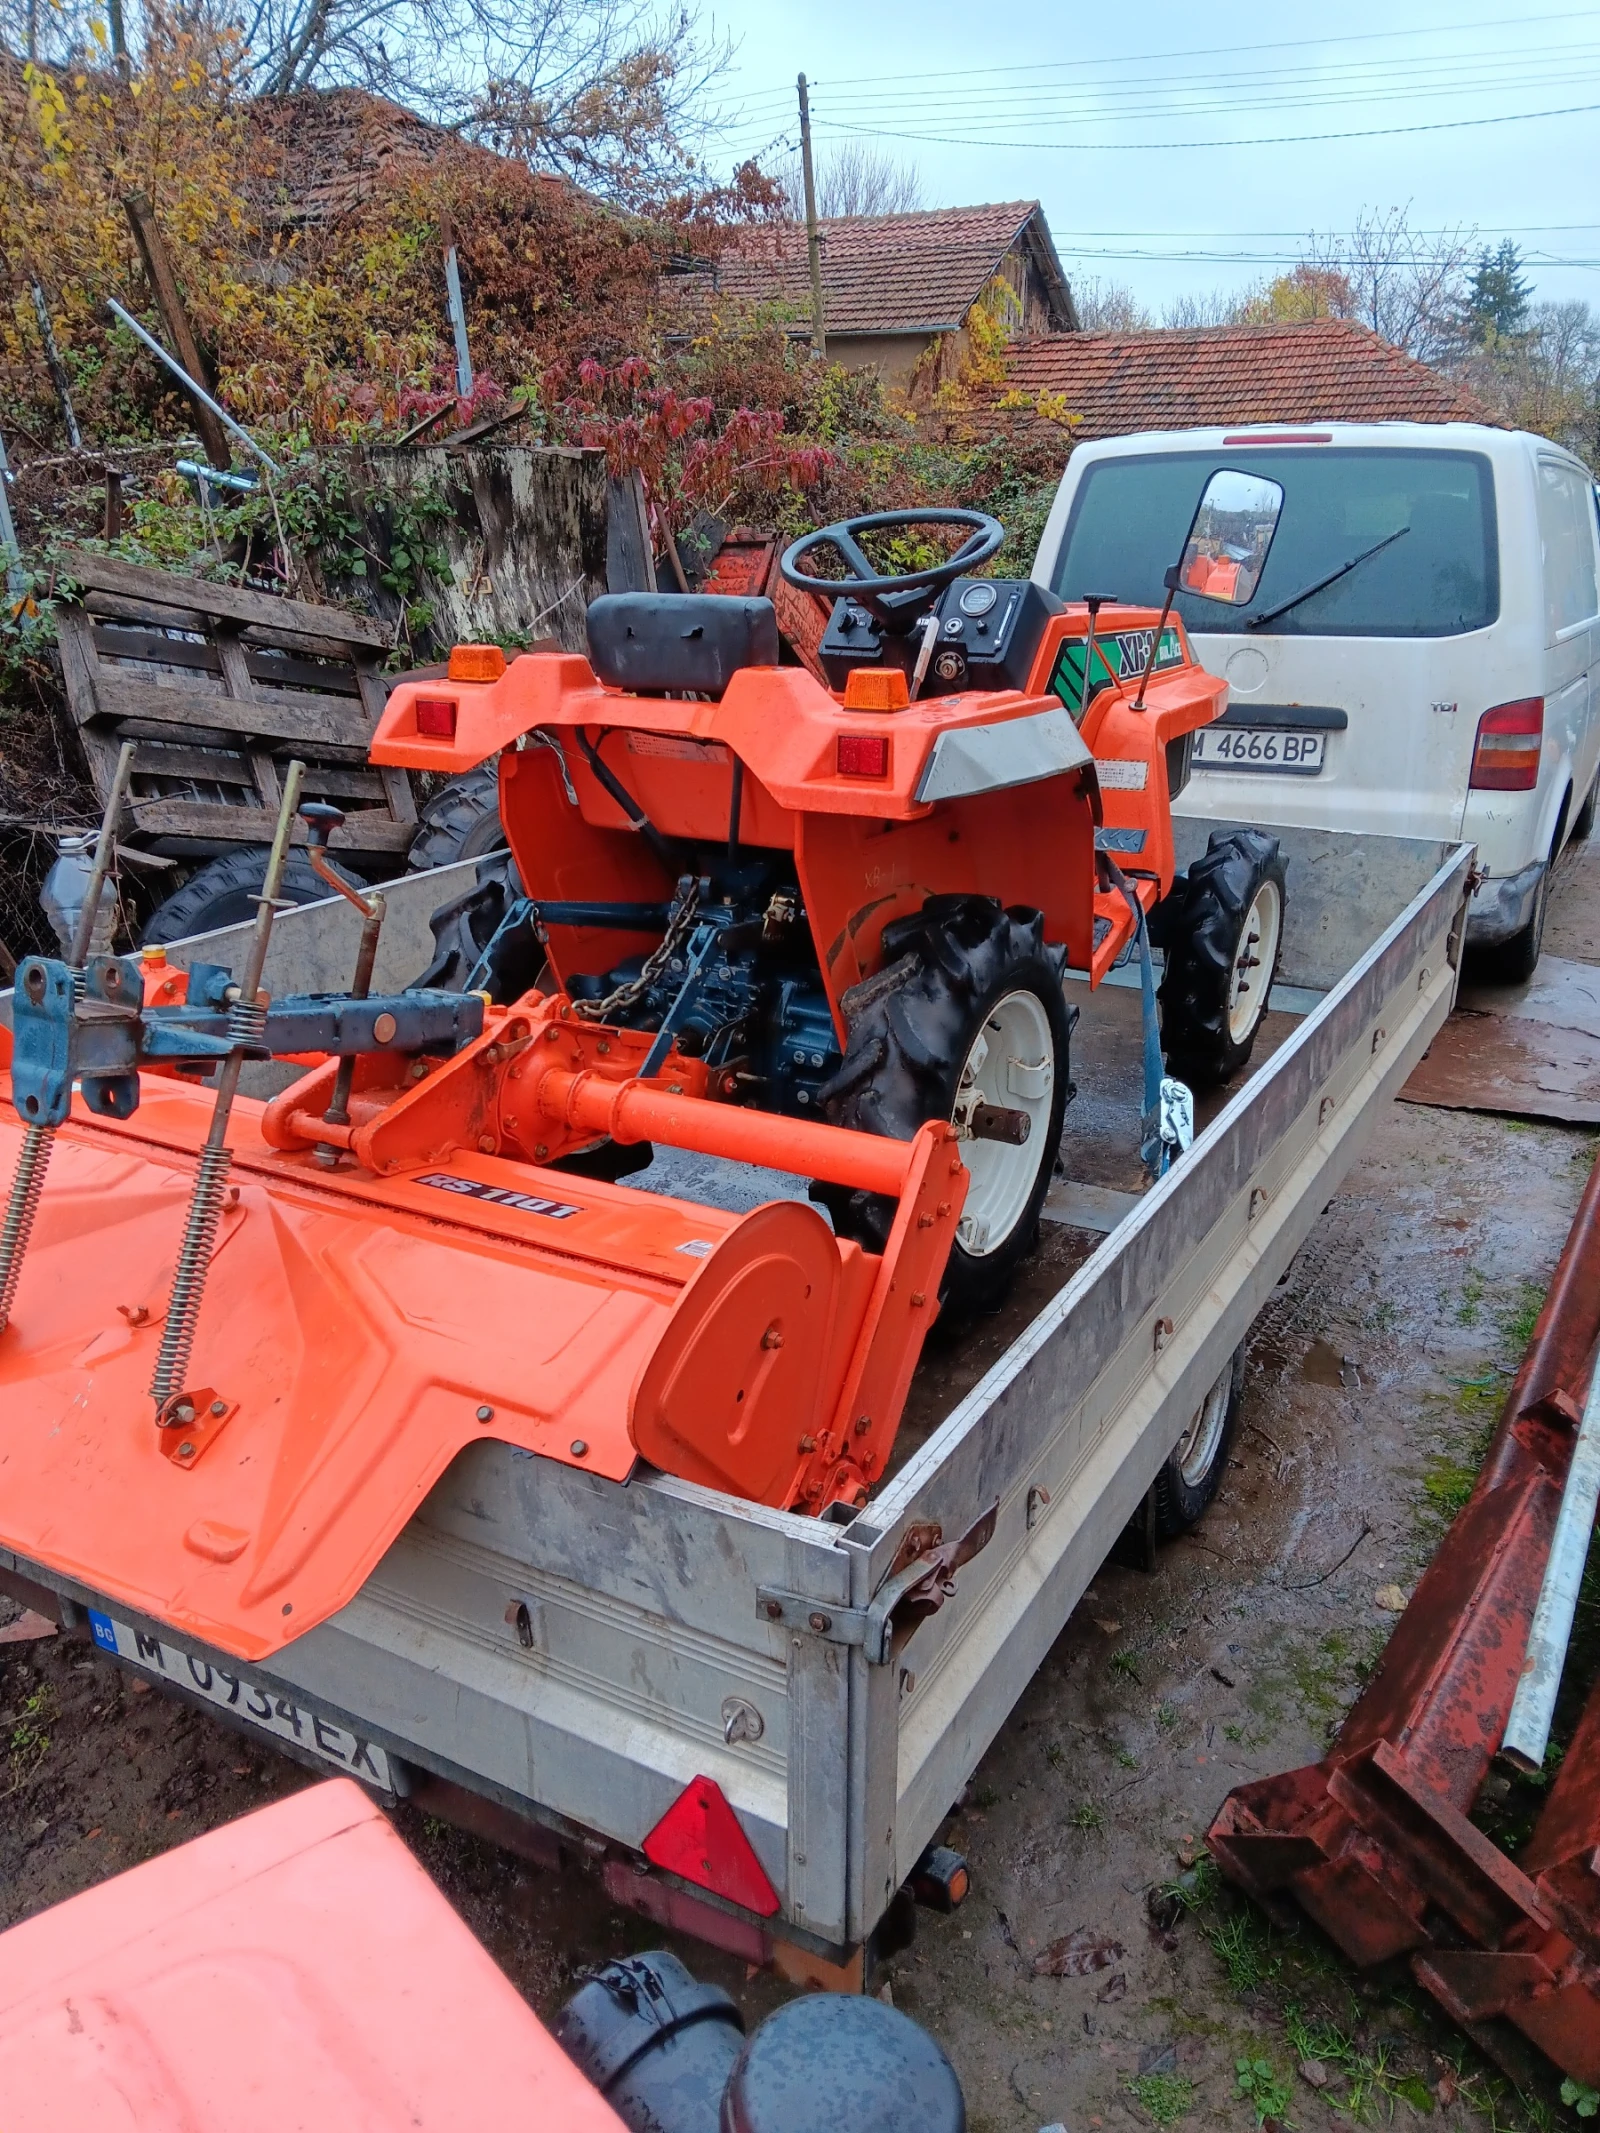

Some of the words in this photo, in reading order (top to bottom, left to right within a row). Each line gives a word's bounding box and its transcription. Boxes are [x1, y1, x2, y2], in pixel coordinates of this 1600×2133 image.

[1431, 701, 1458, 712] TDI
[1217, 734, 1277, 760] 4666
[1283, 736, 1318, 762] BP
[416, 1173, 482, 1193] RS
[480, 1188, 582, 1218] 1101
[94, 1622, 114, 1643] BG
[133, 1629, 165, 1671] M
